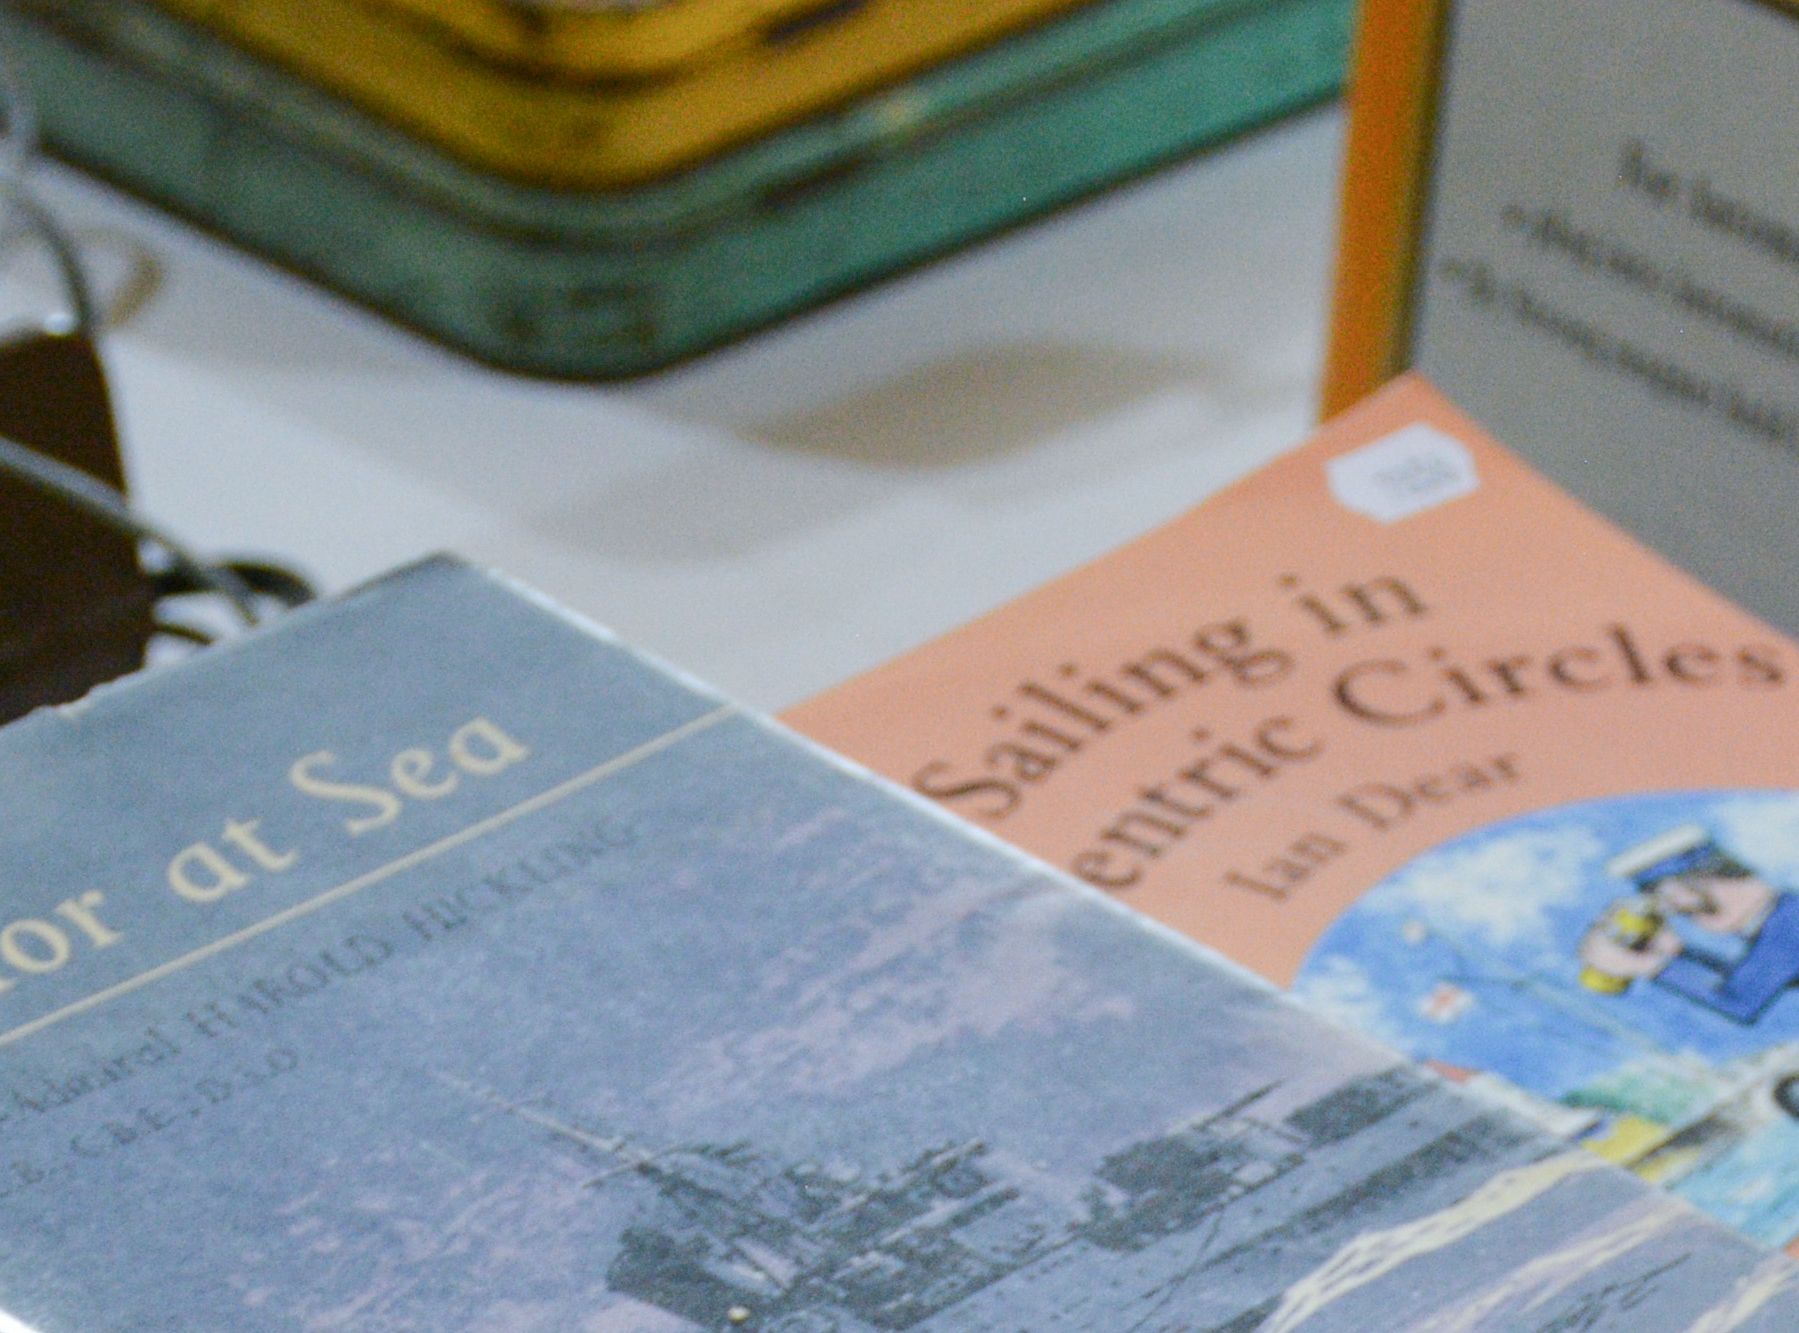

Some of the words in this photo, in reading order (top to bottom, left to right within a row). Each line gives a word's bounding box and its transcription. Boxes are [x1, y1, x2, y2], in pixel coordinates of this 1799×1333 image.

[911, 616, 1294, 824] Sailing
[1279, 572, 1428, 636] in
[1333, 622, 1794, 730] Circles
[165, 812, 303, 901] at
[289, 713, 536, 837] Sea
[1223, 830, 1348, 902] Ian
[1334, 742, 1527, 832] Dear
[186, 928, 394, 1042] HAROLD
